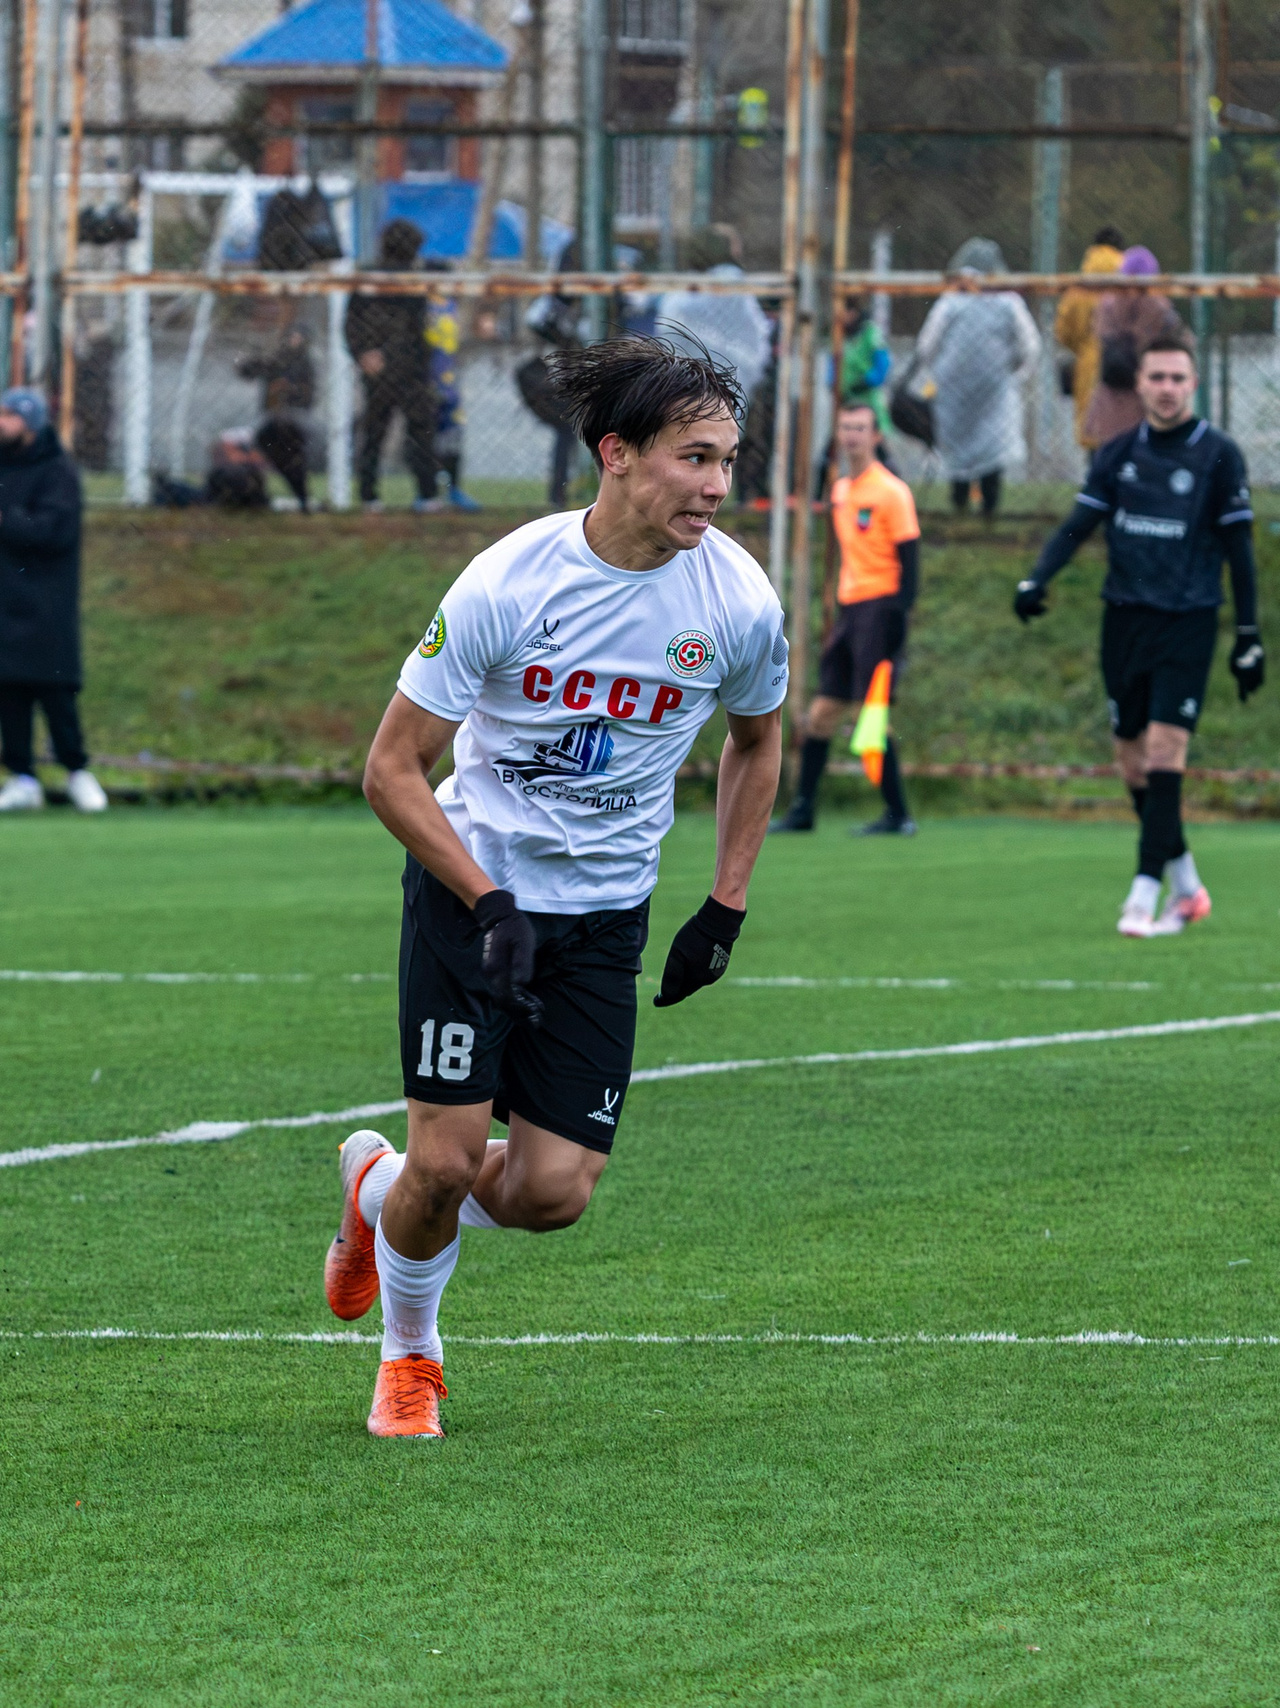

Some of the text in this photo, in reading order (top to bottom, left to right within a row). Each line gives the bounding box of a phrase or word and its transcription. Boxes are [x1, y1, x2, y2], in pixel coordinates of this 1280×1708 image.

[526, 639, 564, 652] JÖGEL
[522, 664, 684, 724] СССР
[417, 1018, 475, 1081] 18
[587, 1110, 615, 1126] JÖGEL
